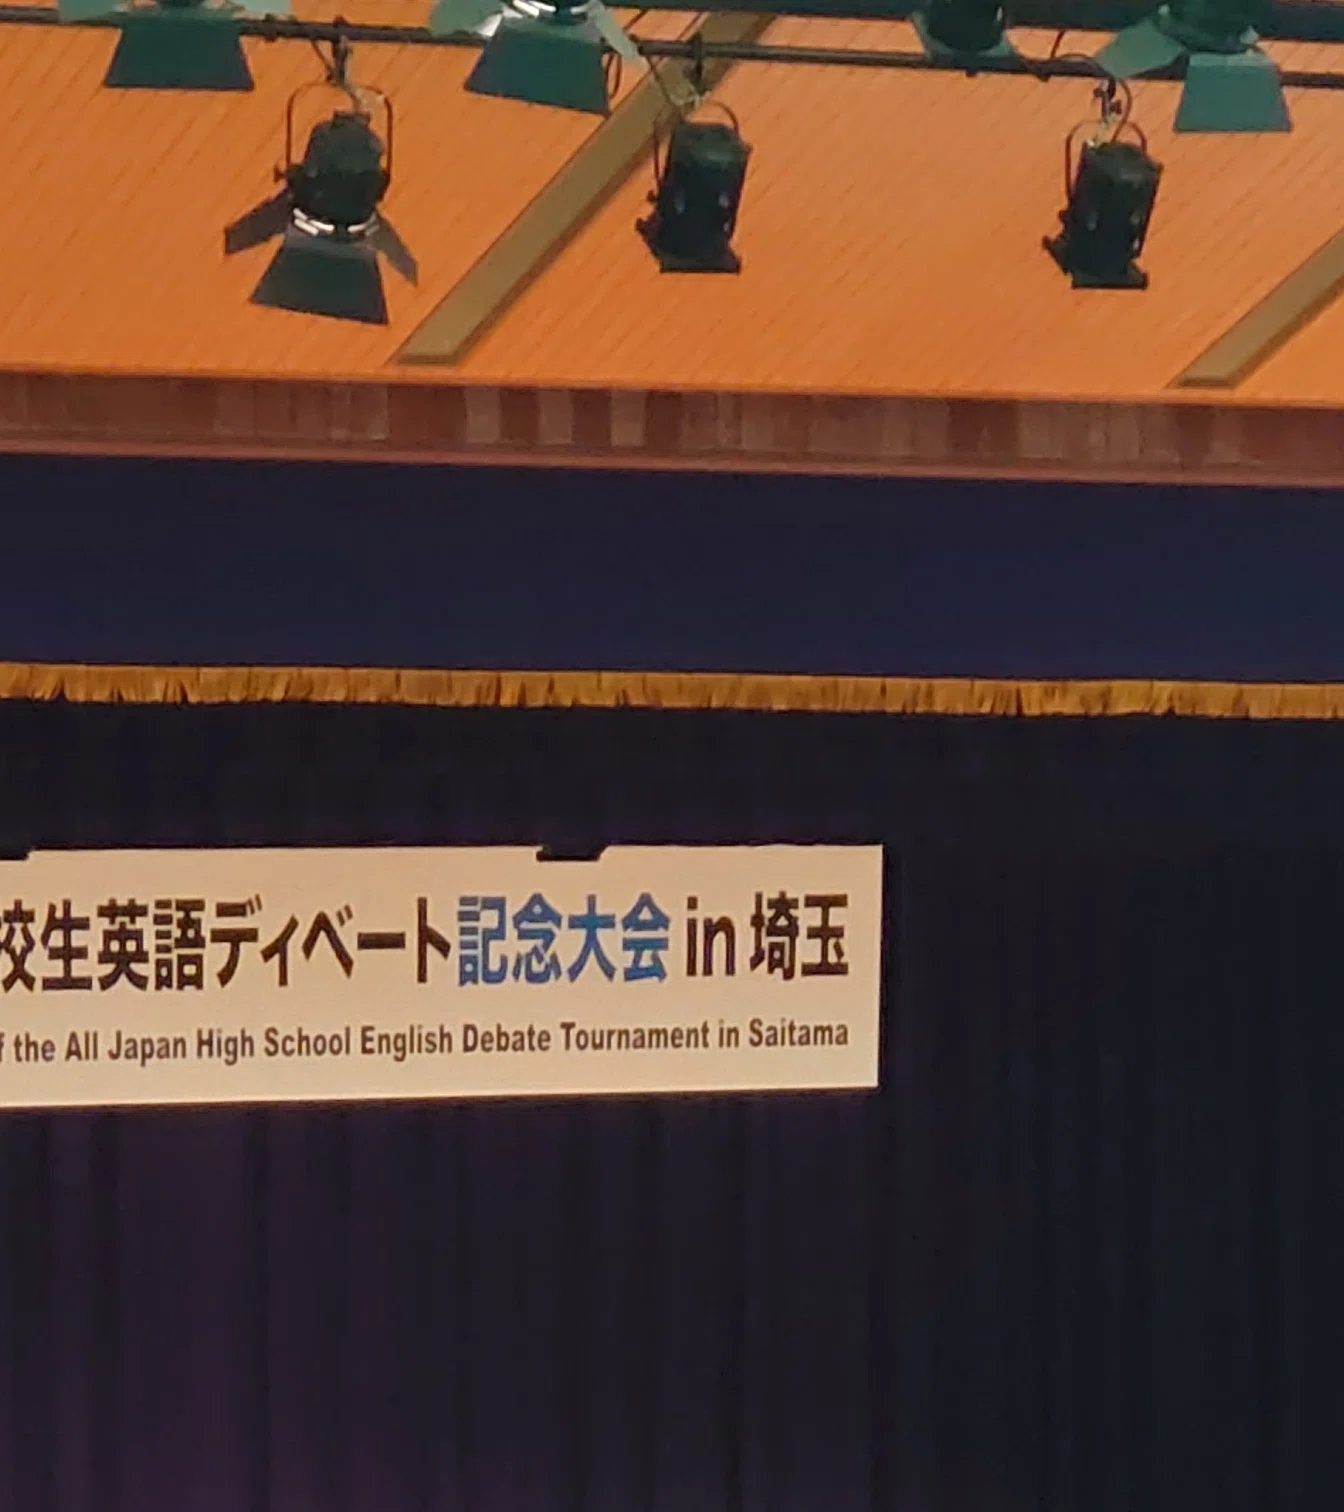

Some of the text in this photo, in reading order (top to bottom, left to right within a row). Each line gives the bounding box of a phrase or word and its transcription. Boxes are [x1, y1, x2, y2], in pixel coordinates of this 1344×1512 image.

[685, 896, 737, 977] in
[749, 890, 850, 981] 埼玉
[12, 1031, 56, 1063] the
[64, 1029, 99, 1062] All
[106, 1028, 187, 1068] Japan
[196, 1026, 255, 1067] High
[263, 1024, 351, 1058] School
[360, 1022, 453, 1063] English
[462, 1021, 552, 1054] Debate
[559, 1019, 710, 1052] Tournament
[718, 1018, 740, 1049] in
[748, 1016, 849, 1048] Saitama
